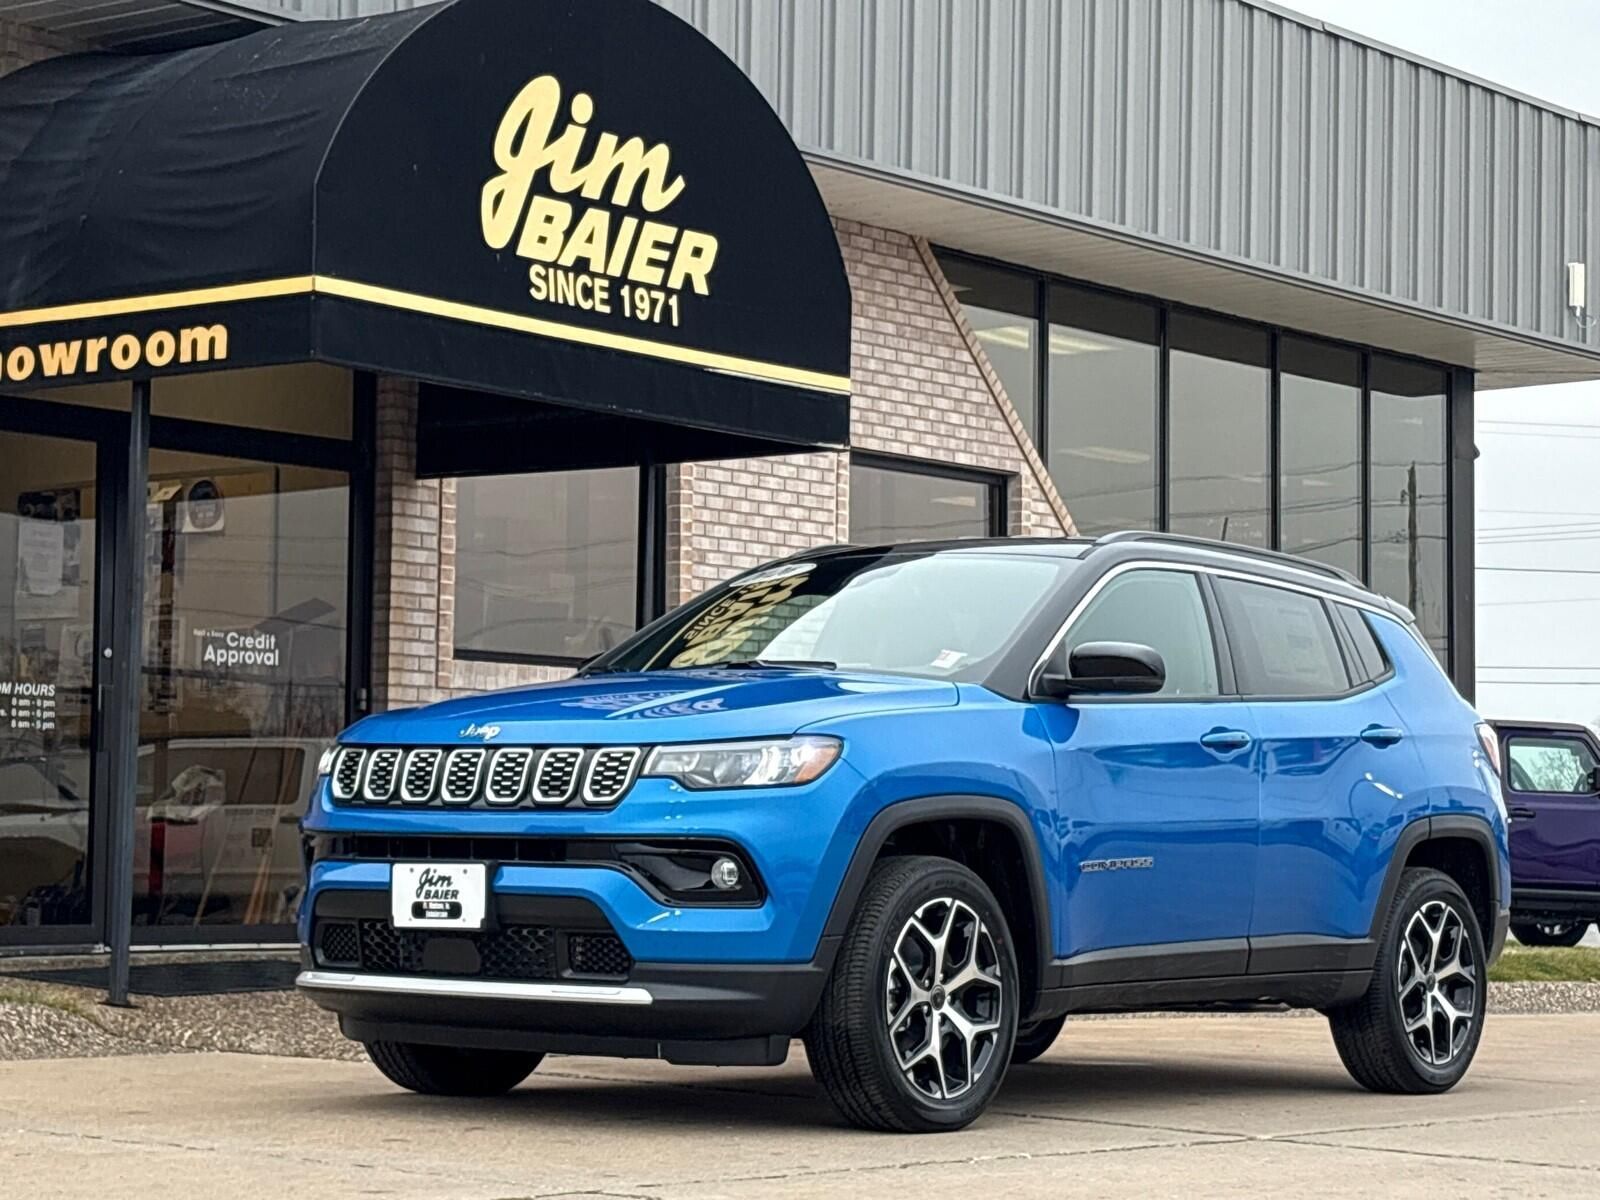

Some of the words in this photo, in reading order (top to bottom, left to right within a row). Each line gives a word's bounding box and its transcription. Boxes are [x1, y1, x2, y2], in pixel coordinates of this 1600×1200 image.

[481, 75, 686, 249] Jim
[516, 195, 718, 296] BAIER
[529, 264, 611, 314] SINCE
[620, 285, 679, 327] 1971
[0, 324, 228, 381] owroom
[203, 644, 279, 667] Approval
[226, 632, 276, 649] Credit
[0, 682, 12, 694] M
[14, 682, 56, 697] HOURS
[415, 867, 453, 899] Jim
[423, 889, 460, 900] BAIER
